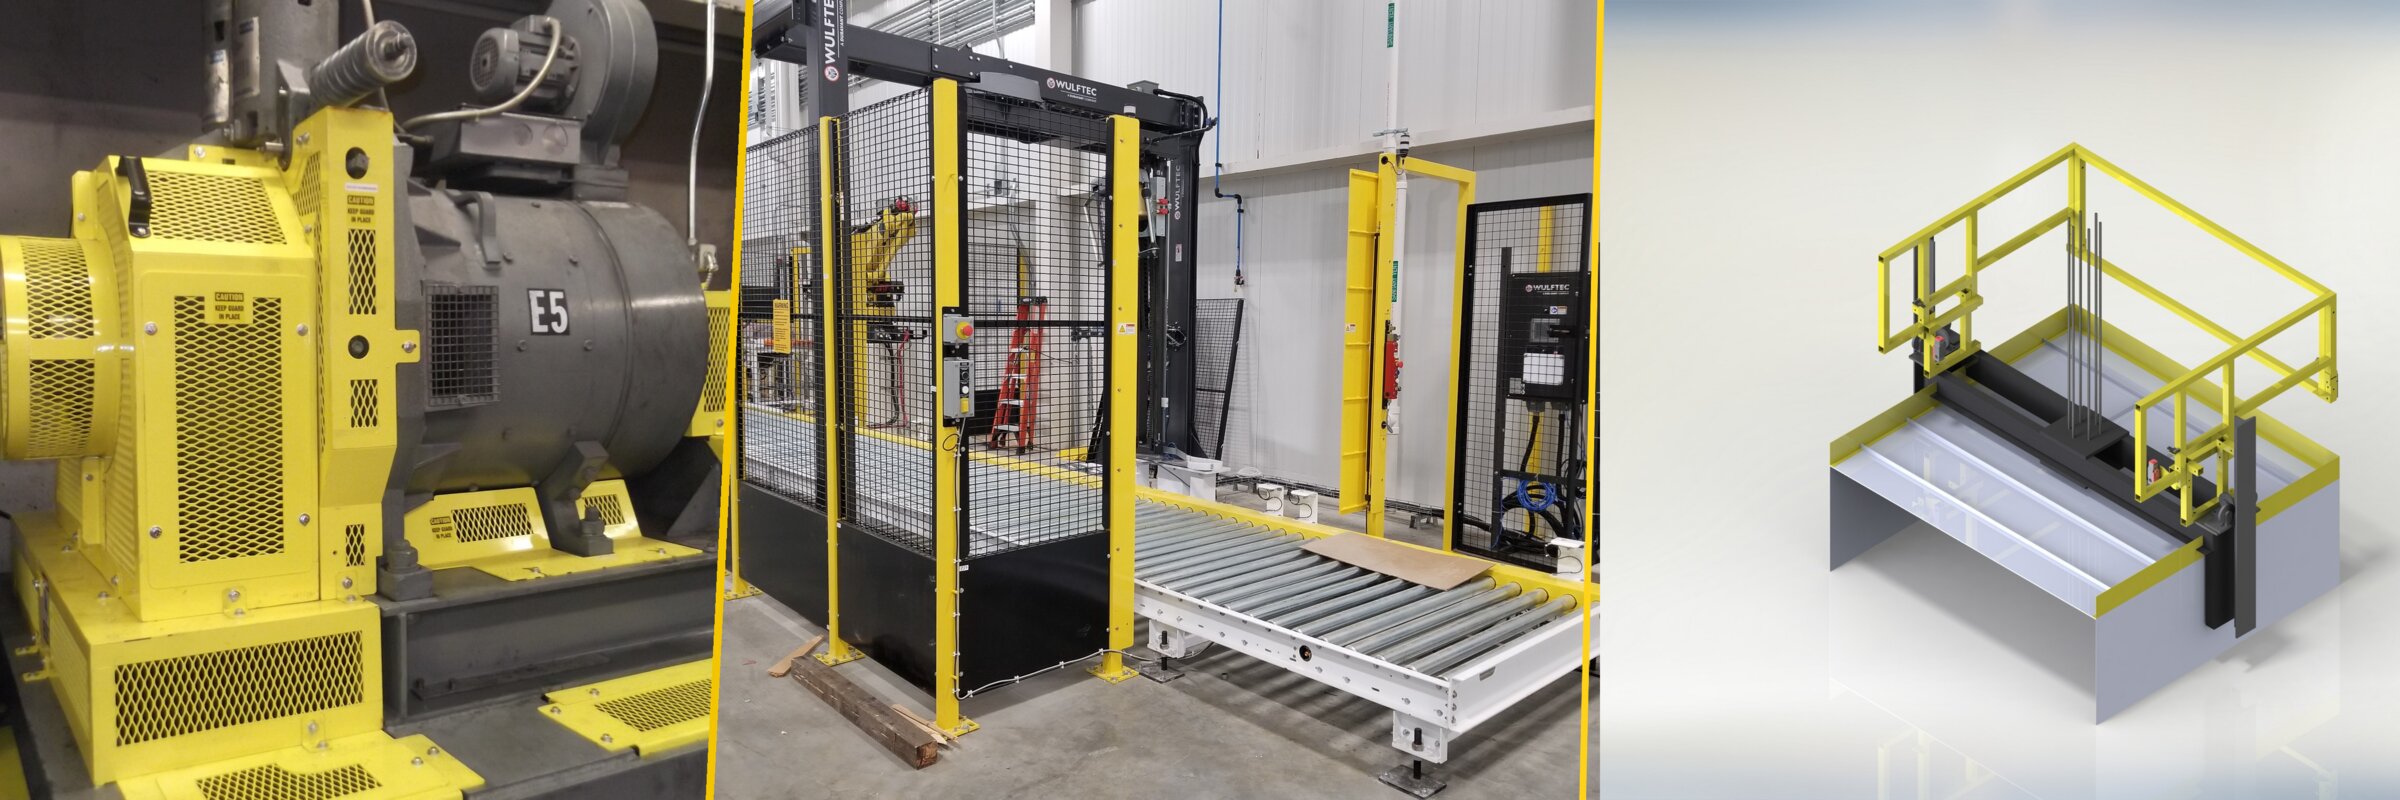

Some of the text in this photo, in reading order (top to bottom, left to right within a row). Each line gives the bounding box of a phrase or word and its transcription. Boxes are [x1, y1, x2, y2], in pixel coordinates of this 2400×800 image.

[824, 0, 836, 64] WULFTE
[1056, 79, 1097, 97] WULFTEC
[215, 292, 243, 301] CAUTION
[529, 290, 568, 333] E5
